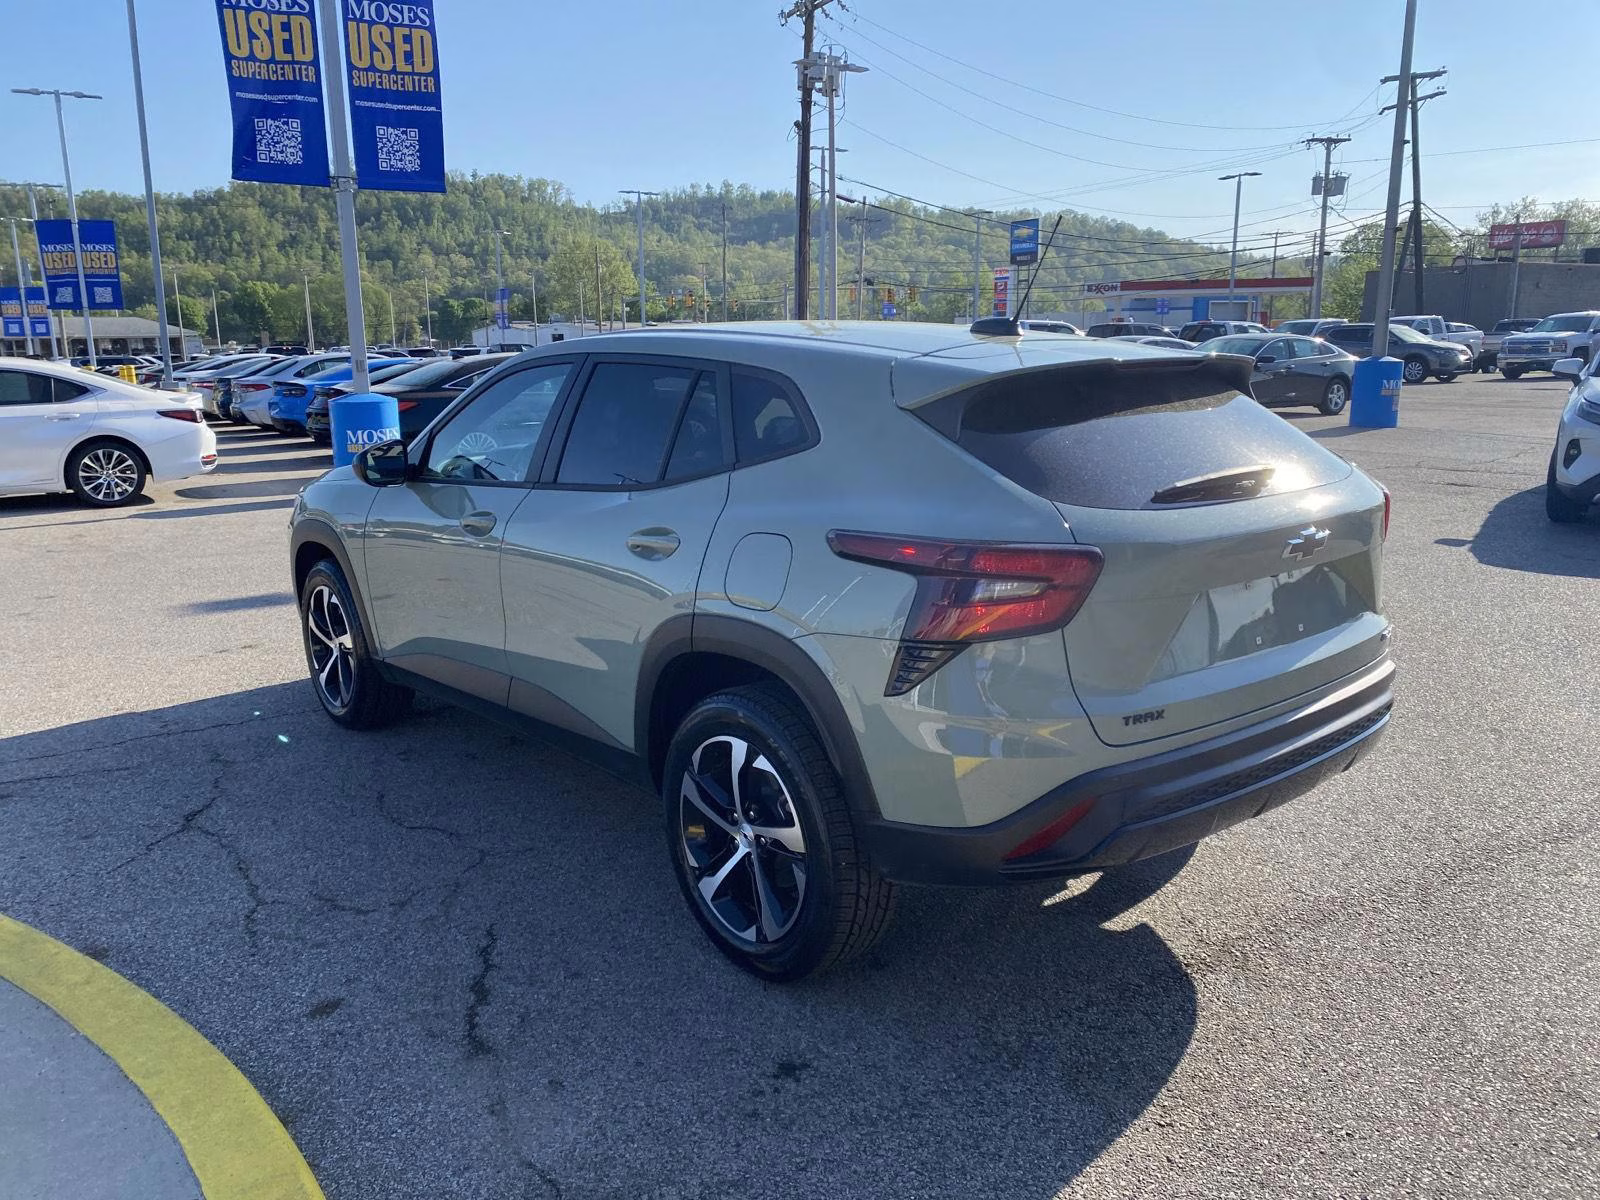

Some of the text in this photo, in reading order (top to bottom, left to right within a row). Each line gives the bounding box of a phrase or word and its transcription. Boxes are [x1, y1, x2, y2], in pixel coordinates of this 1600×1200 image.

[348, 0, 430, 27] MOSES
[223, 8, 314, 62] USED
[347, 21, 434, 73] USED
[231, 59, 316, 83] SUPERCENTER
[352, 69, 436, 93] SUPERCENTER
[42, 244, 74, 252] MOSES
[81, 243, 115, 252] MOSES
[43, 252, 76, 269] USED
[82, 252, 117, 268] USED
[1087, 283, 1118, 294] EXXON
[1122, 709, 1165, 726] TRAX
